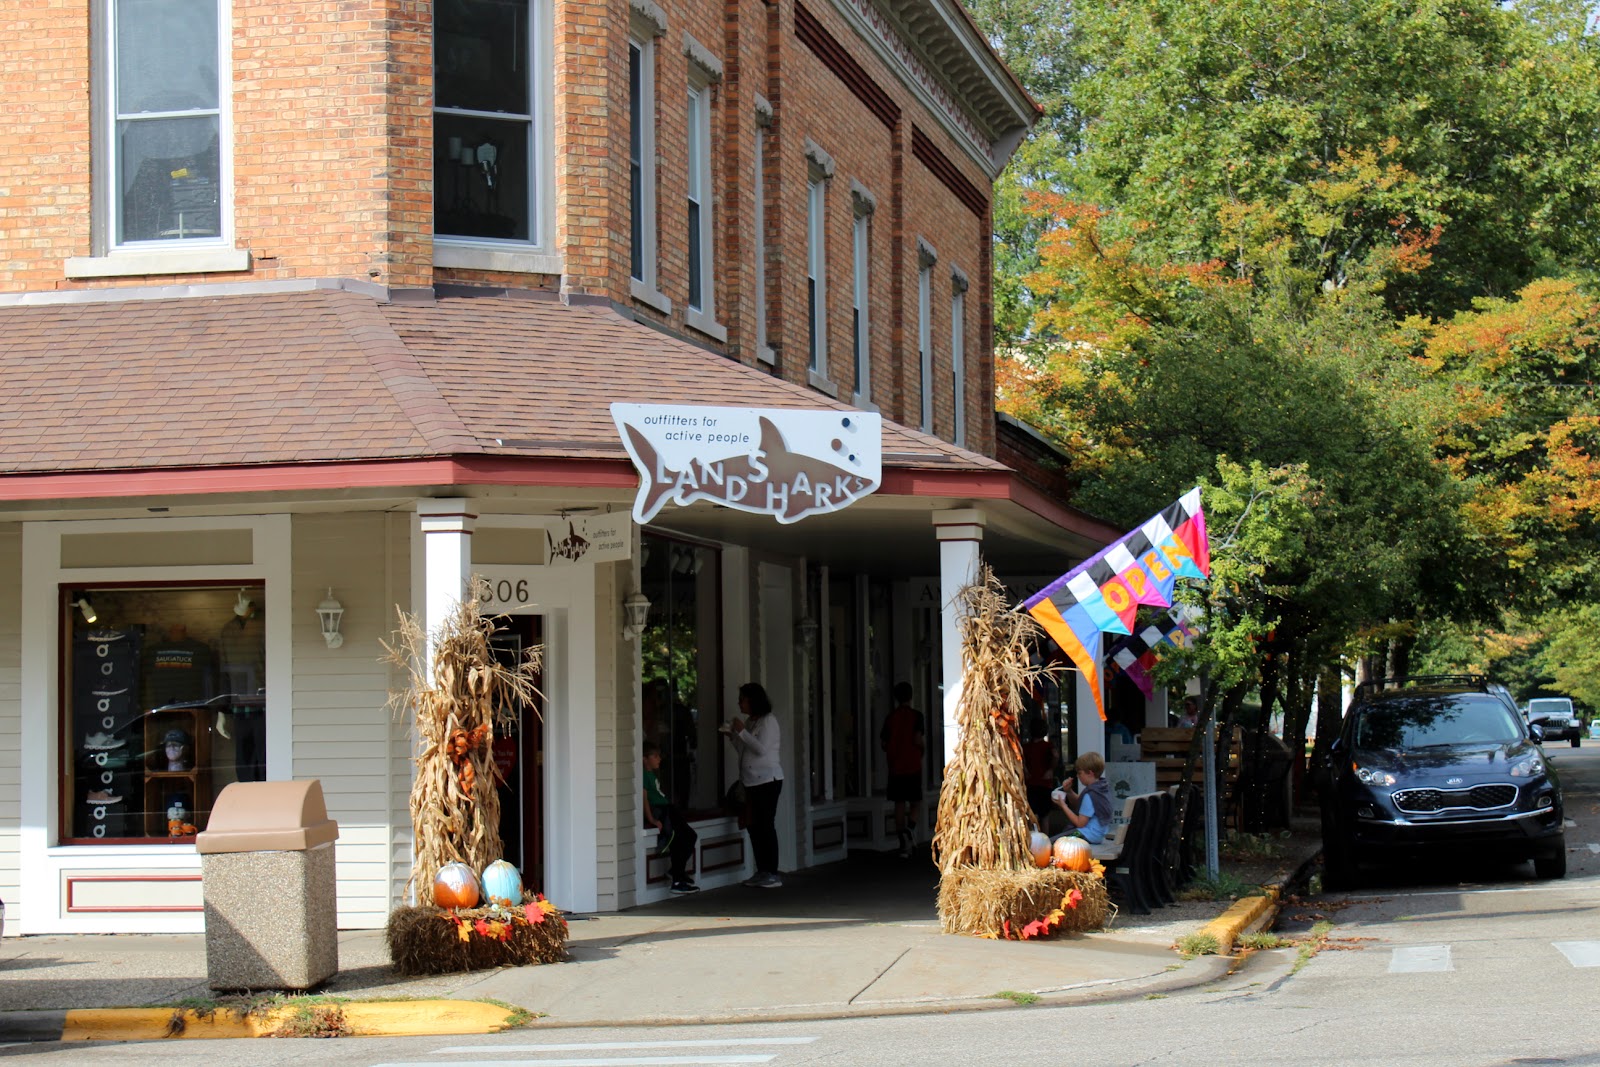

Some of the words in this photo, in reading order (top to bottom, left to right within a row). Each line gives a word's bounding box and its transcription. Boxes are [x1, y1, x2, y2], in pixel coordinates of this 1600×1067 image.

[644, 414, 698, 426] outfitters
[702, 416, 718, 427] for
[665, 431, 702, 441] active
[707, 432, 750, 444] people
[592, 529, 609, 539] outfitters
[610, 540, 624, 551] people
[1102, 533, 1194, 612] OPEN
[480, 578, 529, 603] 306
[155, 655, 193, 663] SAUGATUCK
